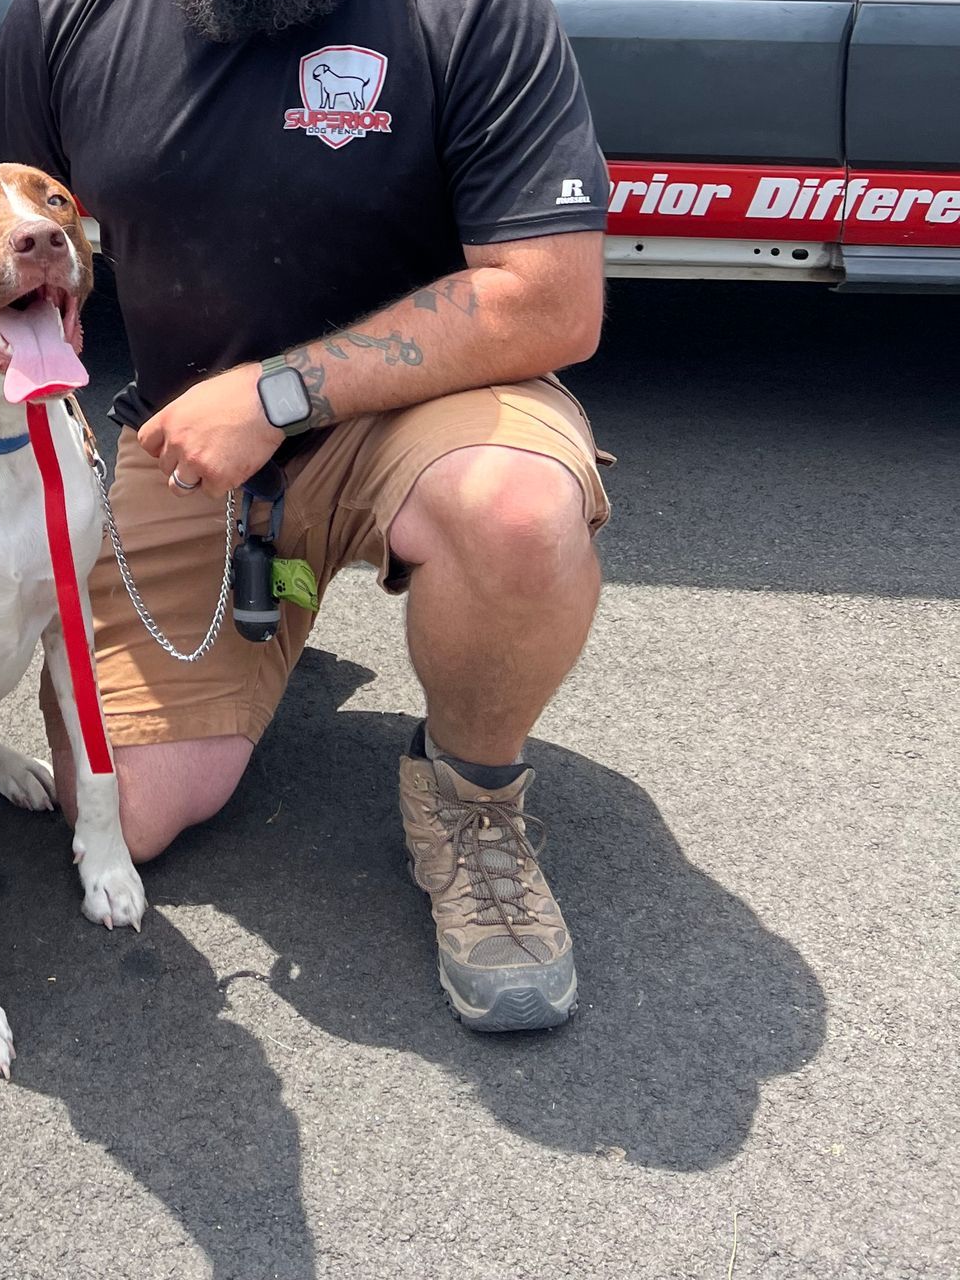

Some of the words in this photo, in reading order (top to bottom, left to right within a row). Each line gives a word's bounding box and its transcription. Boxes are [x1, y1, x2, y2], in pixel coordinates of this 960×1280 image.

[286, 110, 392, 132] SUPERIOR
[330, 127, 364, 136] FENCE
[561, 179, 584, 197] R
[745, 177, 960, 222] Differe
